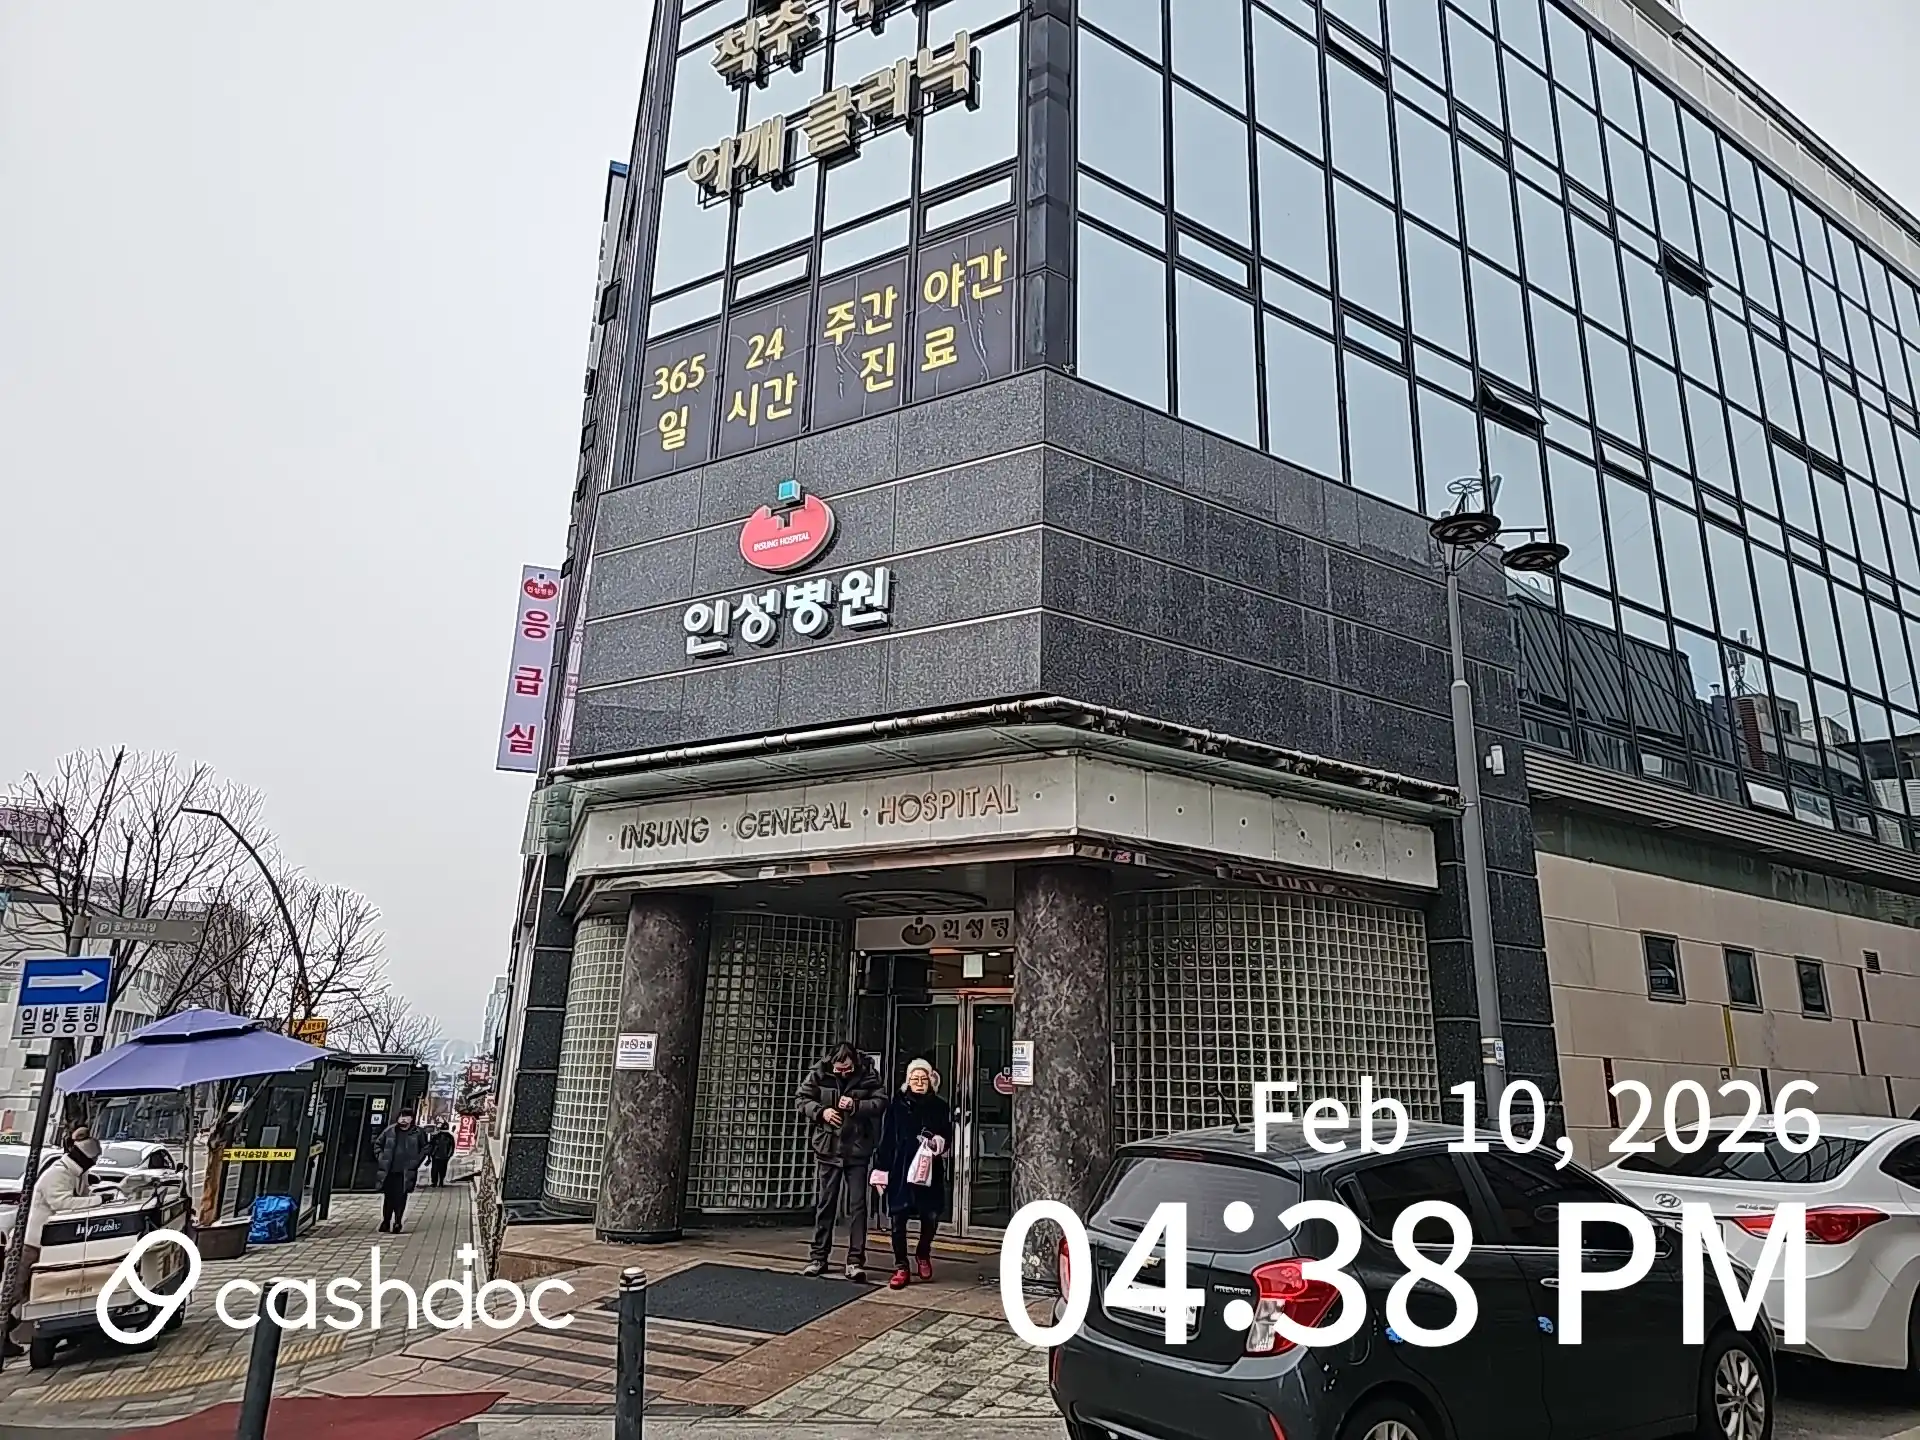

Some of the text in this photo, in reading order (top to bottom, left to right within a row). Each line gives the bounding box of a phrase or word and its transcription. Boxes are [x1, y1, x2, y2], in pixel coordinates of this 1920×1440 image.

[709, 0, 808, 79] 척추
[688, 30, 972, 196] 어깨 클리닉
[652, 246, 1008, 400] 365 24 주간 야간
[658, 405, 689, 451] 일
[727, 372, 798, 427] 시간
[753, 531, 811, 552] INSUNG HOSPITAL
[683, 566, 891, 656] 인성병원
[505, 609, 551, 755] 응급실
[620, 783, 1020, 850] INSUNG GENERAL HOSPITAL
[942, 917, 1010, 941] 인성병
[21, 1006, 101, 1036] 일방통행
